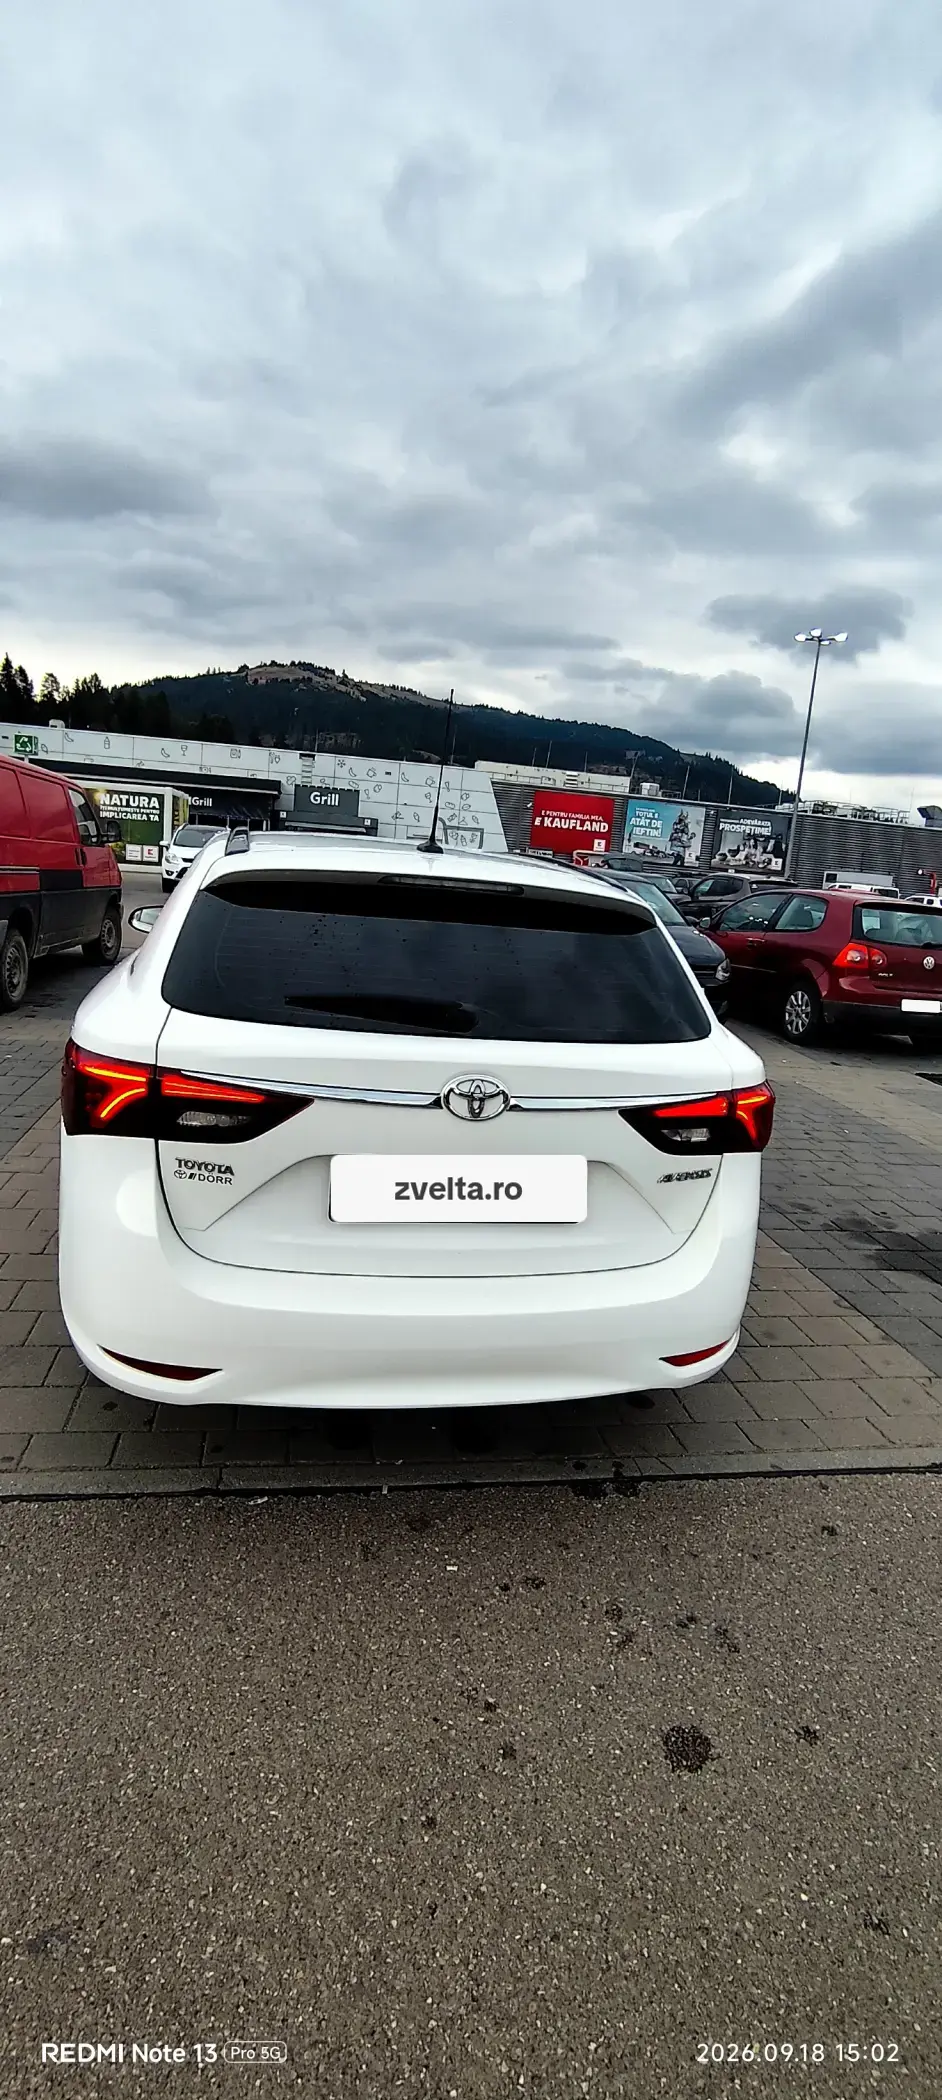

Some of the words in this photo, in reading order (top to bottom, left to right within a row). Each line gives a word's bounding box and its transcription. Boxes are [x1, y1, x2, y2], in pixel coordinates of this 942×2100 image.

[100, 793, 159, 808] NATURA
[310, 791, 339, 806] Grill
[99, 811, 148, 821] IMPLICAREA
[534, 817, 542, 826] E
[544, 817, 608, 832] KAUFLAND
[175, 1157, 235, 1177] TOYOTA
[198, 1173, 232, 1185] DÖRR
